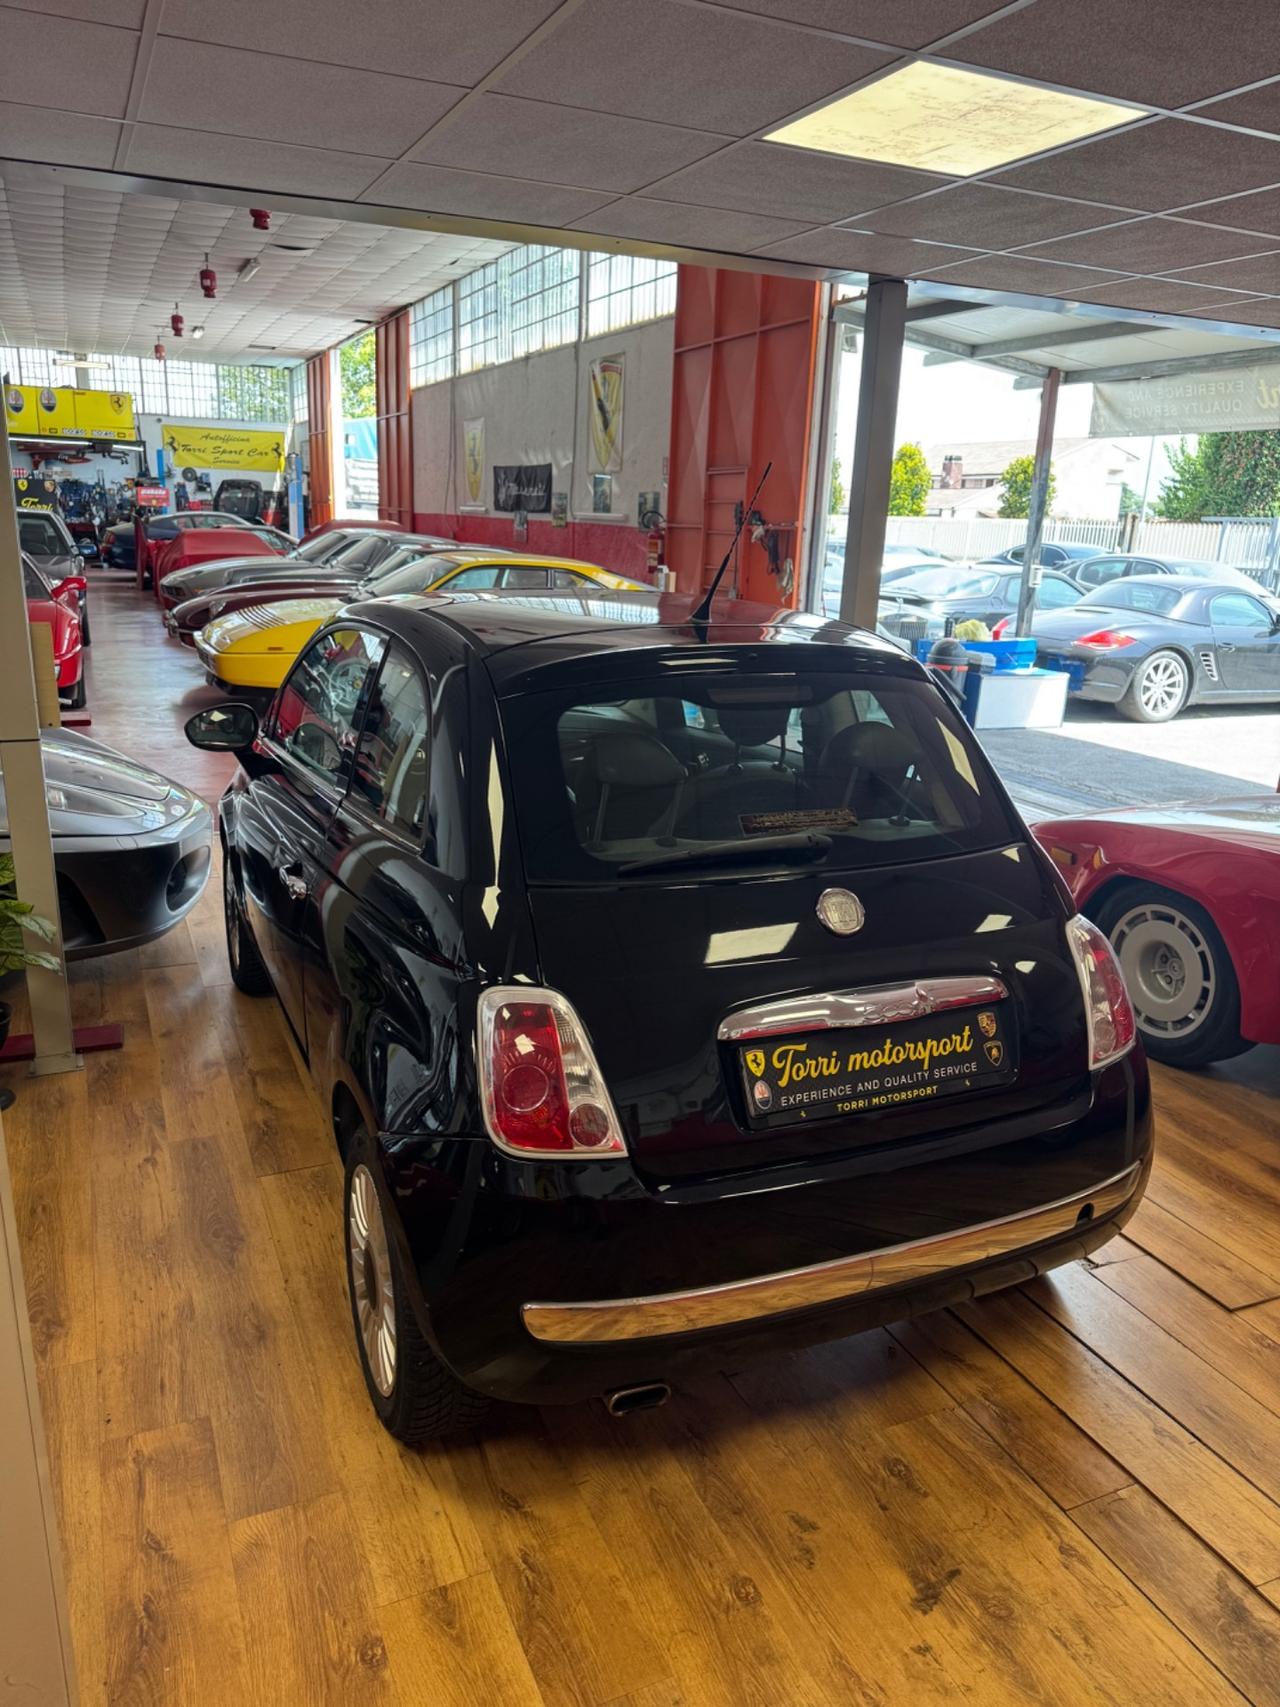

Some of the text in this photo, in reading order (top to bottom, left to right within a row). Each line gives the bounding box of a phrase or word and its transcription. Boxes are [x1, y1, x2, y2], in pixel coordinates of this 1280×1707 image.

[211, 446, 244, 456] Sport
[247, 447, 269, 457] Car
[772, 1025, 974, 1088] Torri motorsport
[781, 1062, 978, 1107] EXPERIENCE AND QUALITY SERVICE
[836, 1085, 939, 1112] TORRI MOTORSPORT
